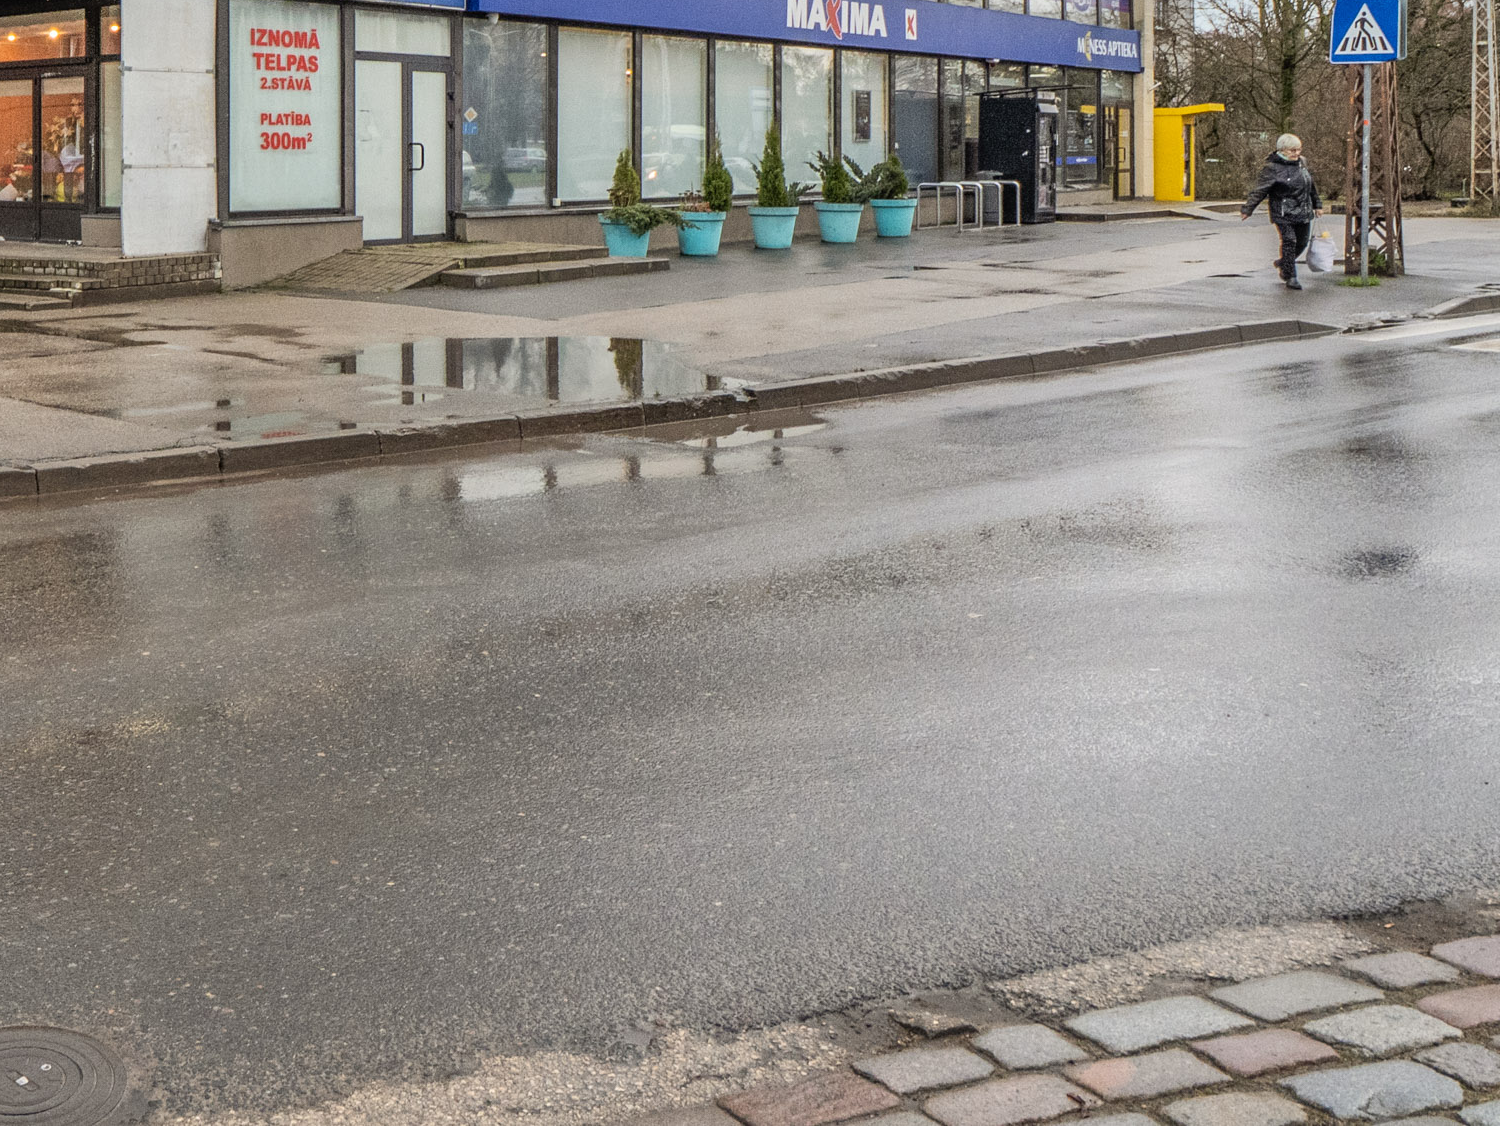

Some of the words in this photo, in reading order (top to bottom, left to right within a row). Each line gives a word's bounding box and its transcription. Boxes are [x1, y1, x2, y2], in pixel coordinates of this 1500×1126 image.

[250, 28, 320, 50] IZNOMĀ
[1107, 40, 1138, 59] APTIEKA
[252, 52, 319, 73] TELPAS
[260, 76, 312, 91] 2.STĀVĀ
[260, 111, 311, 126] PLATĪBA
